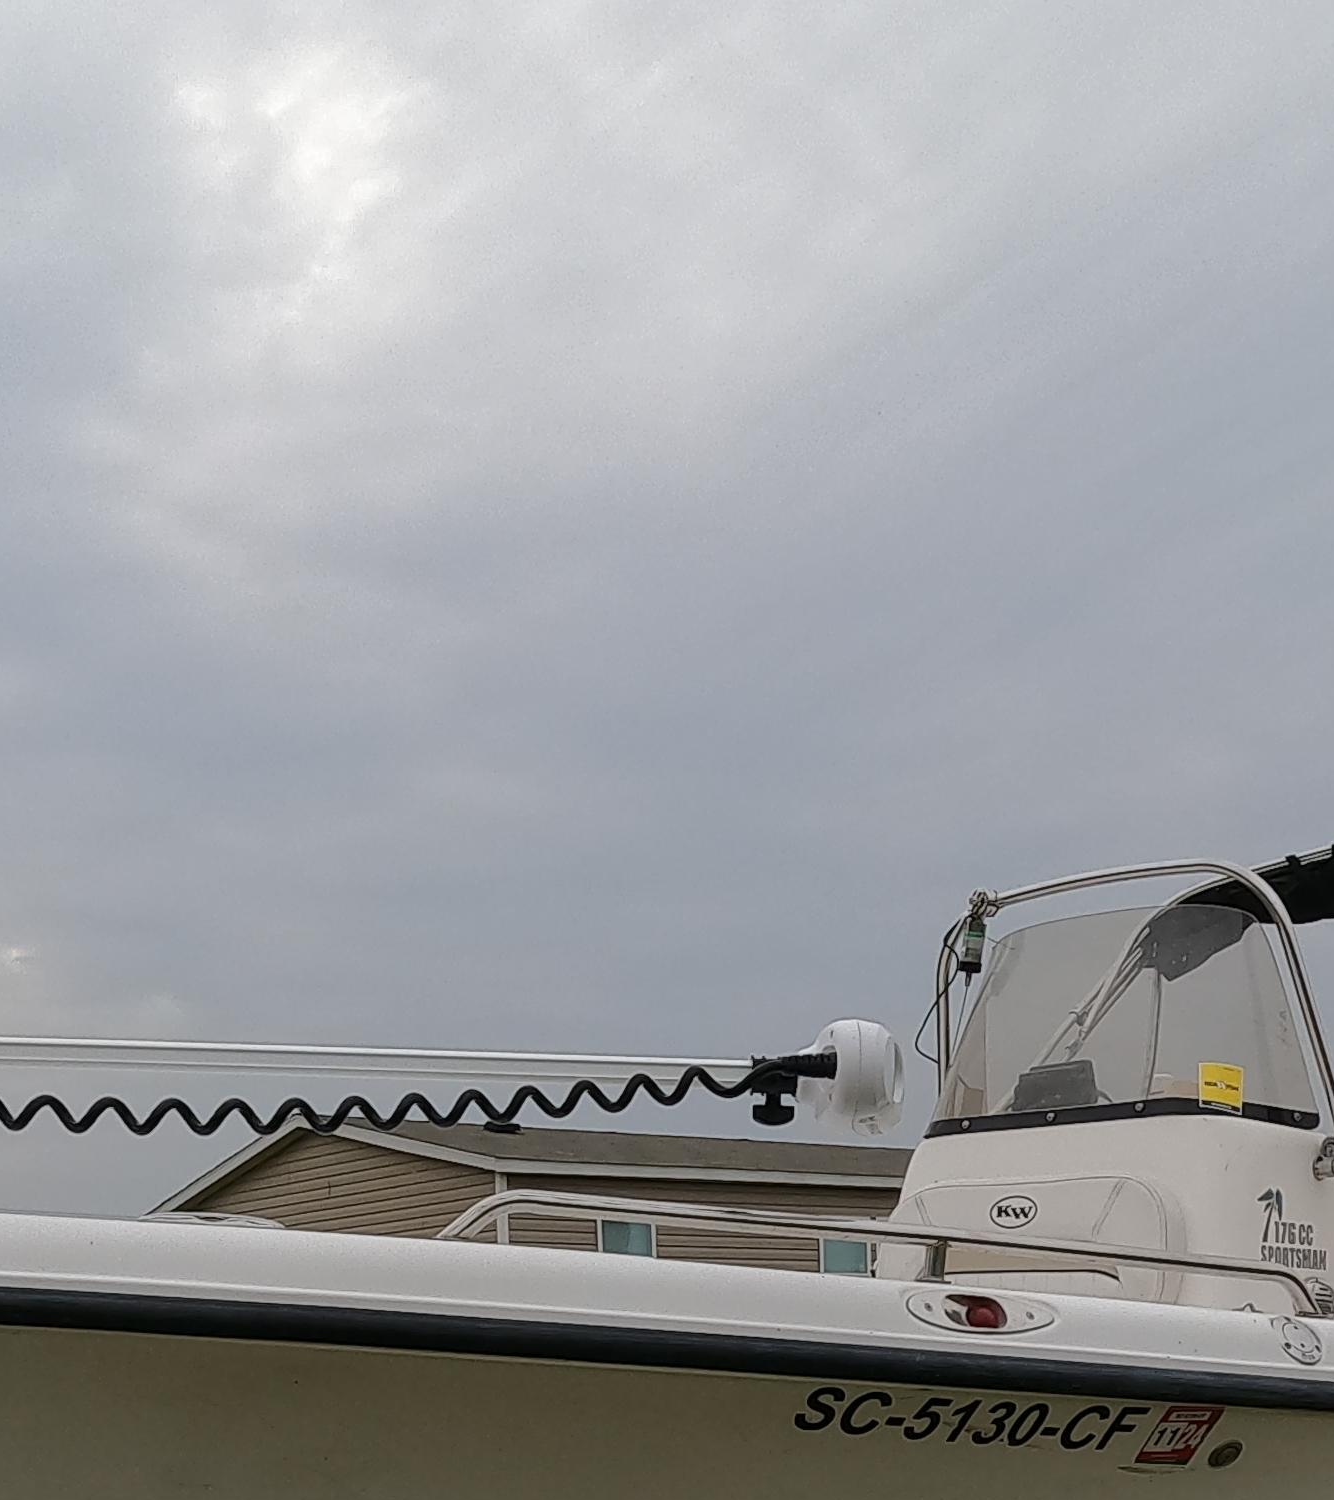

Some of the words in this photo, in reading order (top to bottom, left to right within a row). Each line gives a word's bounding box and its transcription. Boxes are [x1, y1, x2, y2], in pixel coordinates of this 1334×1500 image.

[996, 1204, 1033, 1219] KW
[1298, 1224, 1314, 1246] CC
[1260, 1245, 1327, 1271] SPORTSMAN
[794, 1386, 1152, 1451] SC-5130-CF
